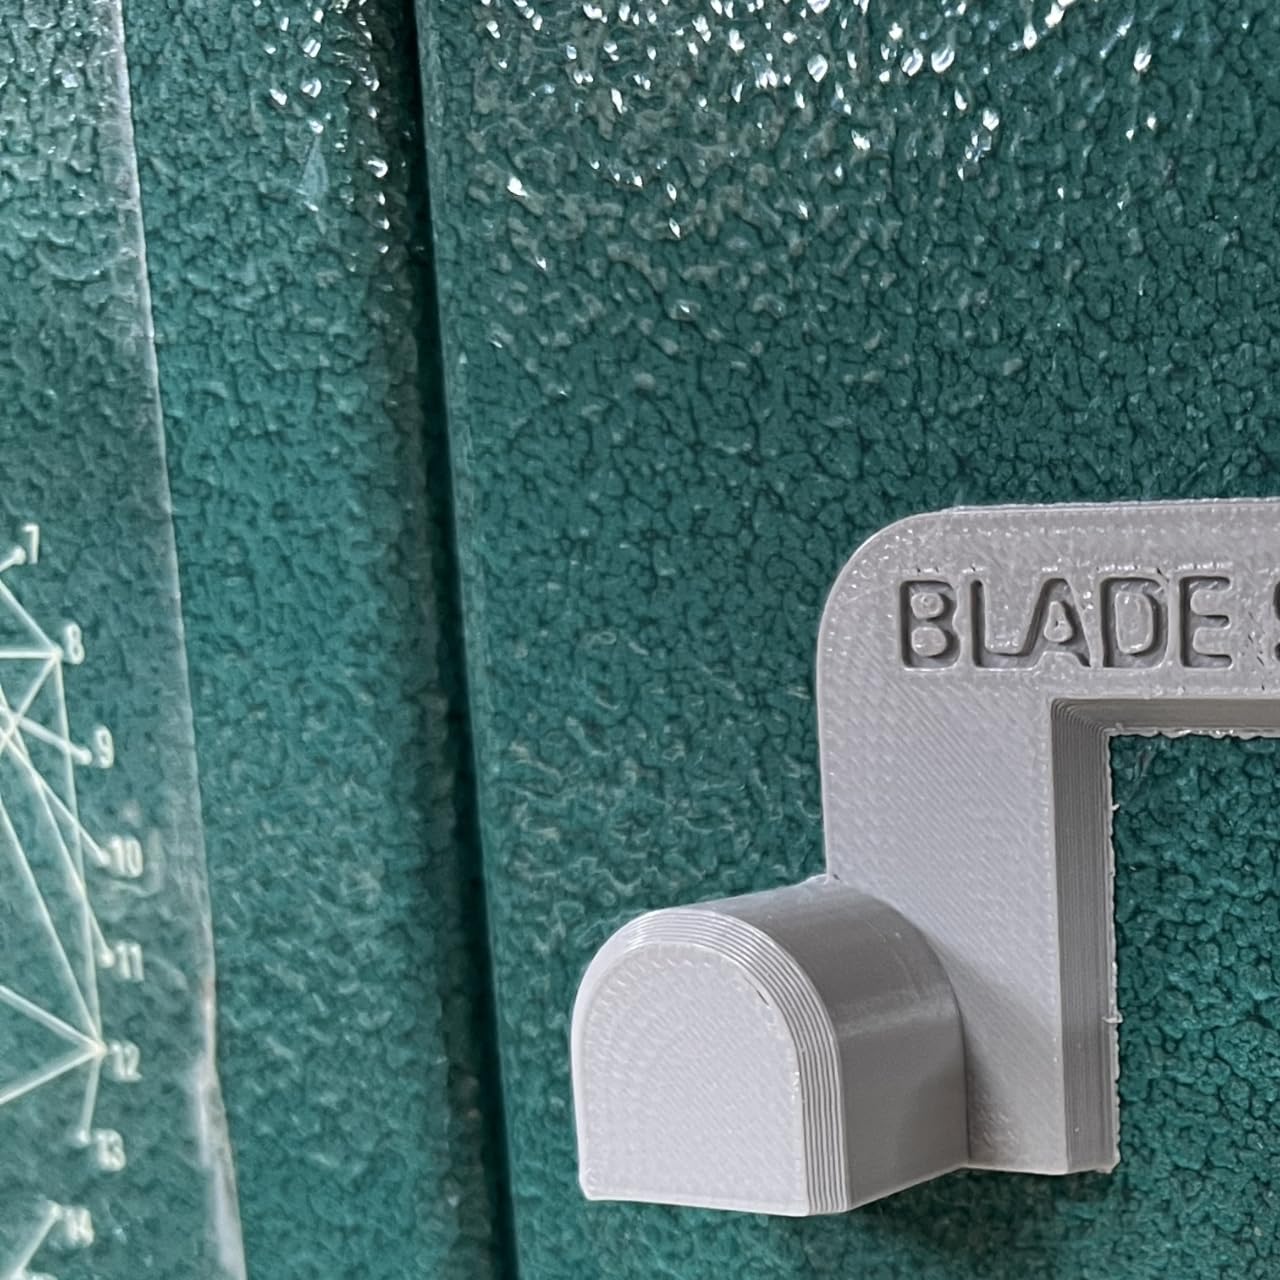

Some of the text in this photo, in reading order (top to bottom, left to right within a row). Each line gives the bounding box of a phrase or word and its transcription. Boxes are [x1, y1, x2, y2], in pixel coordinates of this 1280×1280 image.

[899, 571, 1232, 670] BLADE
[64, 621, 85, 665] 8
[94, 725, 114, 769] 9
[109, 834, 143, 878] 10
[114, 938, 144, 982] 11
[110, 1039, 143, 1083] 12
